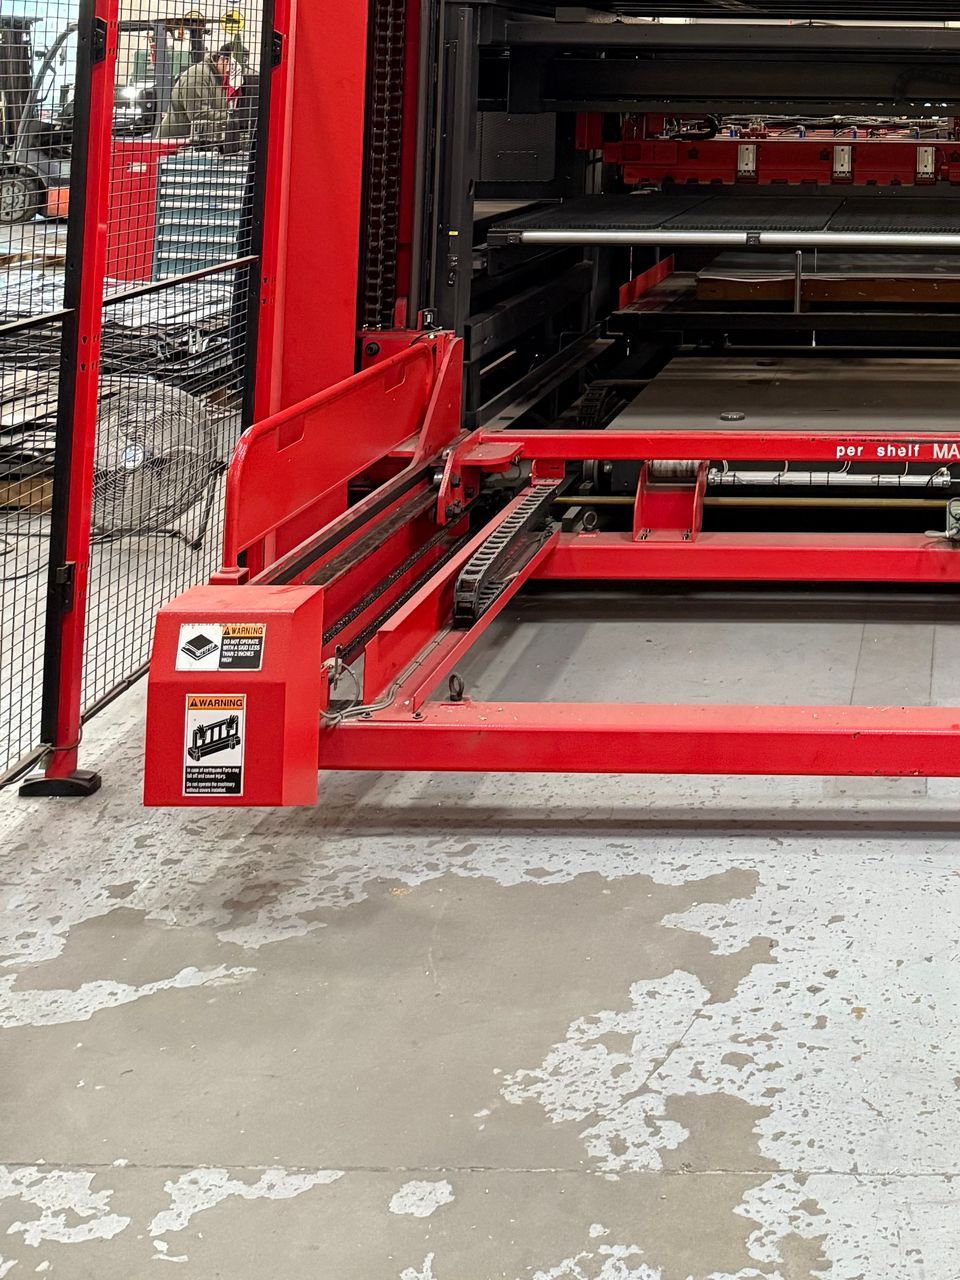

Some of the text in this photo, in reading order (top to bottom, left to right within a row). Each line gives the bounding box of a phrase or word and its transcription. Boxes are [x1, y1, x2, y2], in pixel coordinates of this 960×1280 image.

[836, 445, 863, 459] per
[876, 444, 920, 457] shelf
[231, 626, 263, 635] WARNING
[199, 698, 243, 707] WARNING
